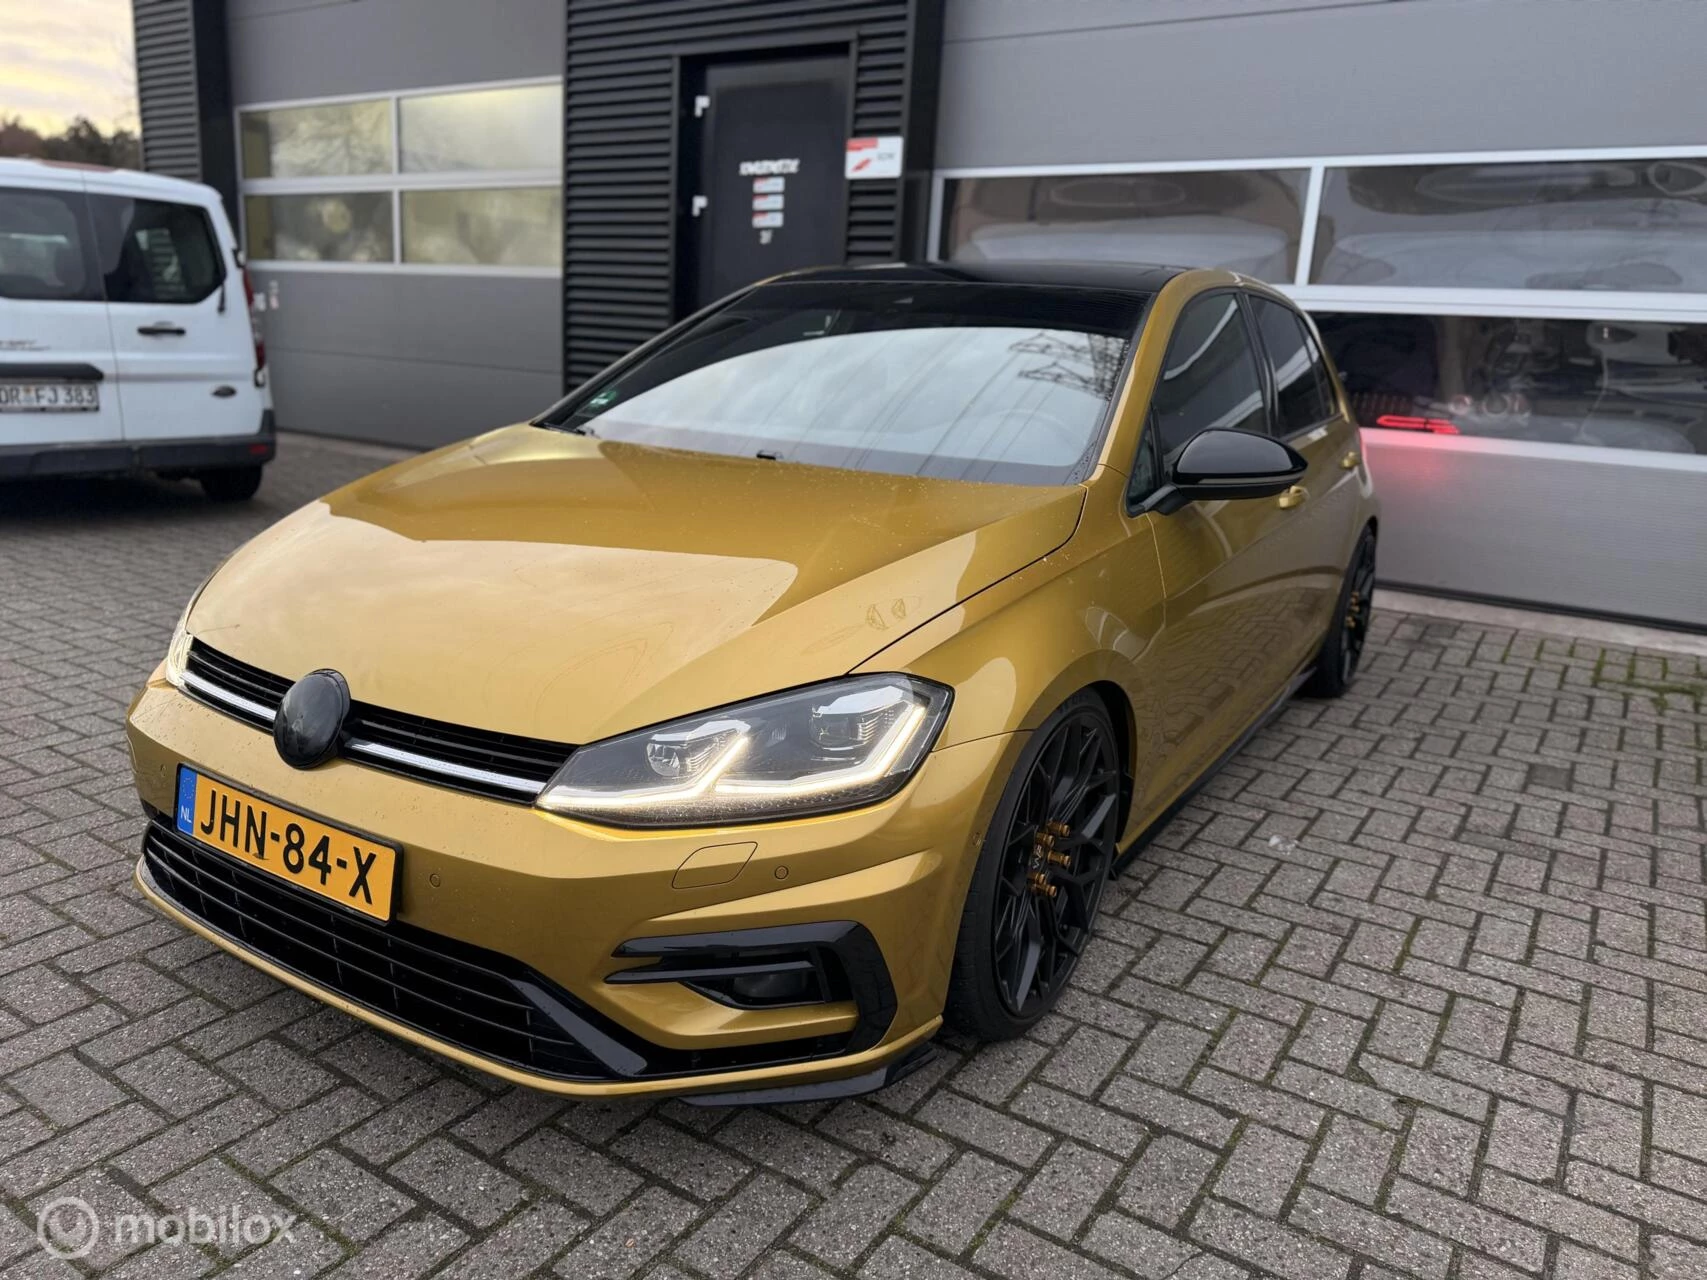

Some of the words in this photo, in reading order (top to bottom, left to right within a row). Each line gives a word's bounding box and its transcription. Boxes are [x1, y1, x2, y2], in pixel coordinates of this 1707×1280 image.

[36, 386, 58, 404] FJ
[180, 805, 192, 823] NL
[200, 789, 376, 905] JHN-84-X
